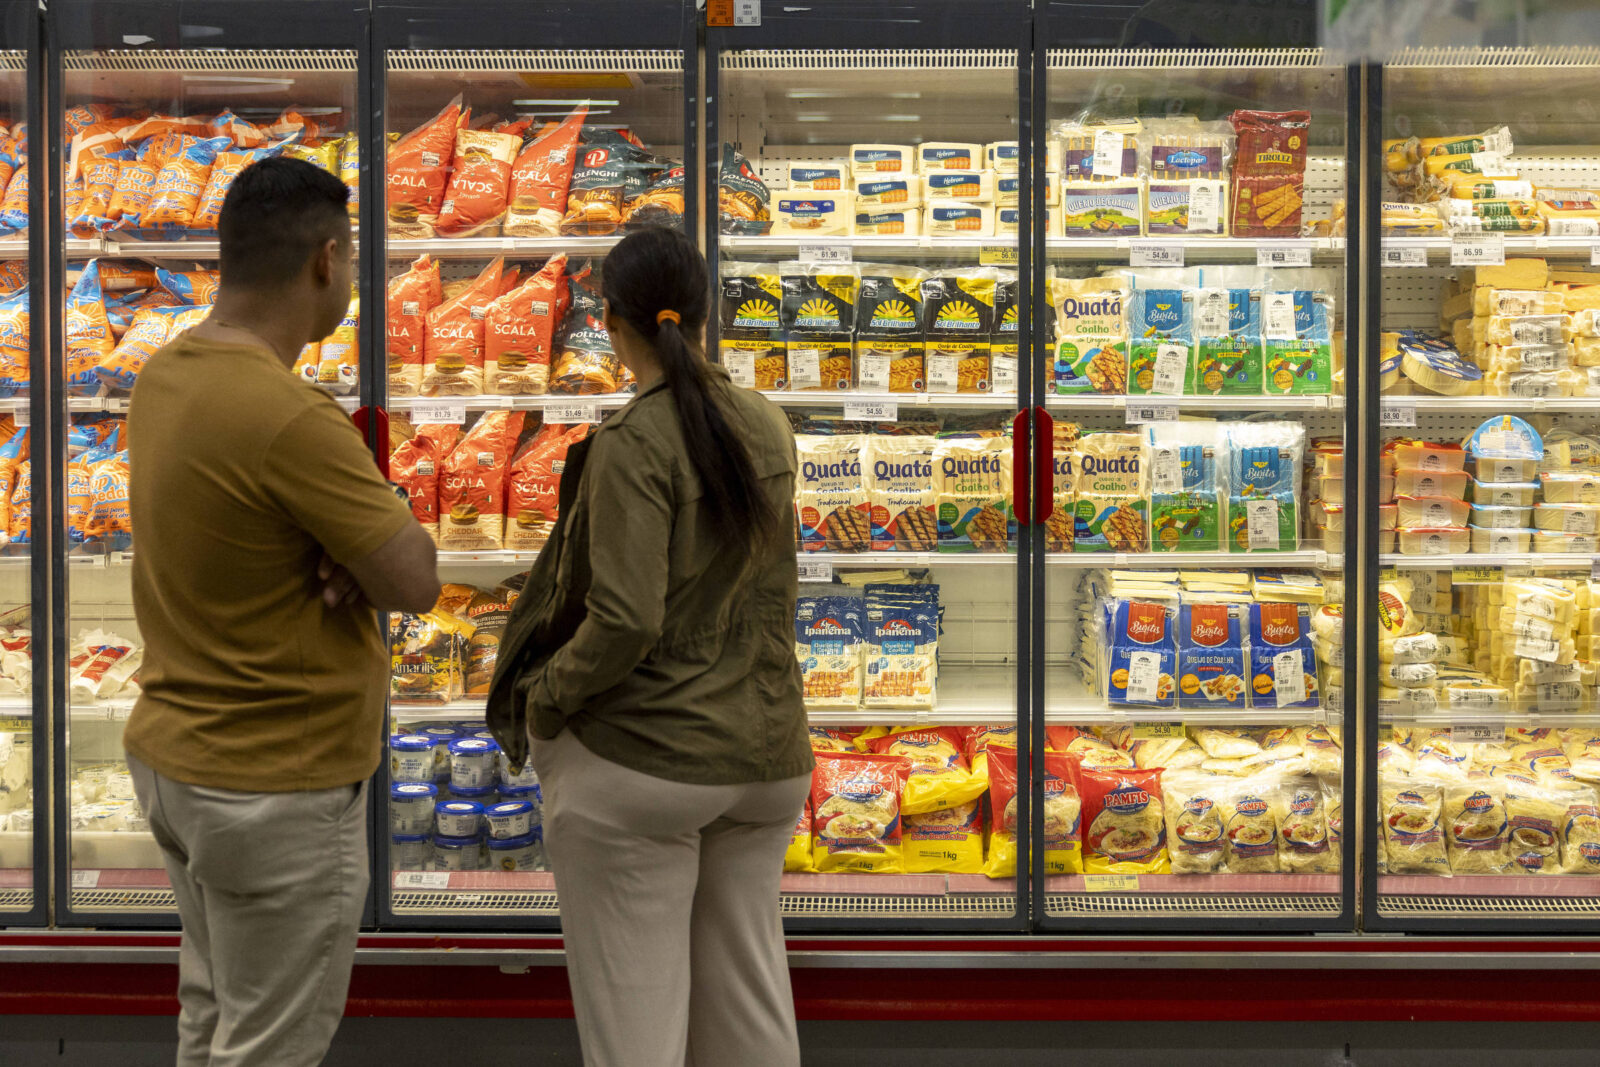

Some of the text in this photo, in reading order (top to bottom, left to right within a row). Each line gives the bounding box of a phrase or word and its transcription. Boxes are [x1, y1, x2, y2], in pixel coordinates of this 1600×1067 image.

[1170, 155, 1205, 166] Lactopar
[1258, 154, 1291, 163] TIROLEZ
[511, 170, 551, 182] SCALA
[452, 180, 494, 193] SCALA
[1063, 297, 1121, 319] Quatá
[734, 319, 780, 327] Sol Brilhante
[795, 318, 840, 327] Sol Brilhante
[870, 319, 916, 328] Sol Brilhante
[934, 320, 980, 329] Sol Brilhante
[433, 327, 474, 339] SCALA
[495, 324, 536, 336] SCALA
[1076, 324, 1110, 334] Coalho
[802, 458, 861, 482] Quatá
[874, 458, 932, 481] Quatá
[942, 454, 1000, 478] Quatá
[1081, 454, 1140, 476] Quatá
[446, 478, 485, 489] SCALA
[515, 482, 556, 496] SCALA
[955, 483, 989, 492] Coalho
[1093, 482, 1127, 491] Coalho
[447, 527, 483, 535] CHEDDAR
[805, 625, 851, 636] ipanema
[875, 626, 921, 637] ipanema
[1187, 656, 1206, 664] QUEIJO
[1207, 656, 1213, 664] DE
[395, 662, 437, 674] Amarilis
[1104, 791, 1149, 807] PAMFIS
[1236, 800, 1267, 811] PAMFIS
